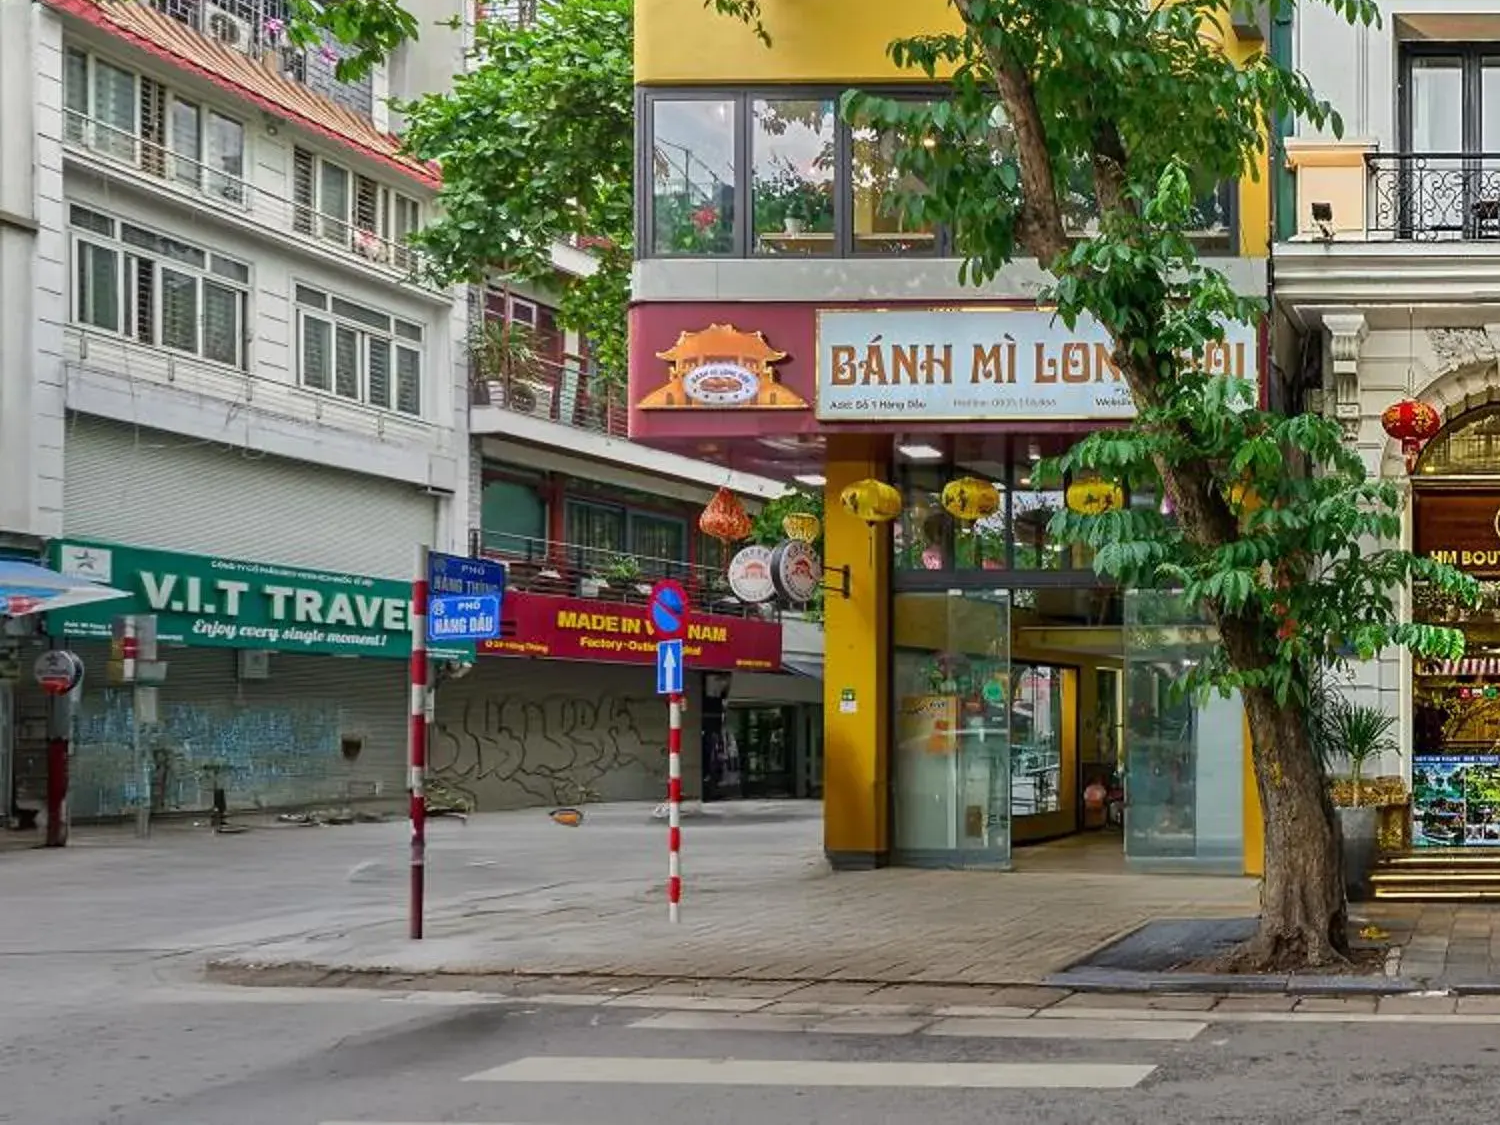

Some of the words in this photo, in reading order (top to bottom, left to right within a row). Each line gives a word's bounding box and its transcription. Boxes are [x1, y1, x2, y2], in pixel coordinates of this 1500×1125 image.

[830, 334, 953, 385] BÁNH
[970, 332, 1017, 384] MÌ
[1034, 341, 1122, 384] LON
[139, 570, 249, 617] V.I.T
[262, 584, 413, 632] TRAVE
[456, 599, 481, 611] PHỐ
[191, 618, 237, 640] Enjoy
[239, 626, 280, 643] every
[281, 627, 326, 645] single
[326, 633, 388, 647] moment!
[433, 615, 467, 635] HÀNG
[557, 610, 620, 633] MADE
[621, 619, 641, 634] IN
